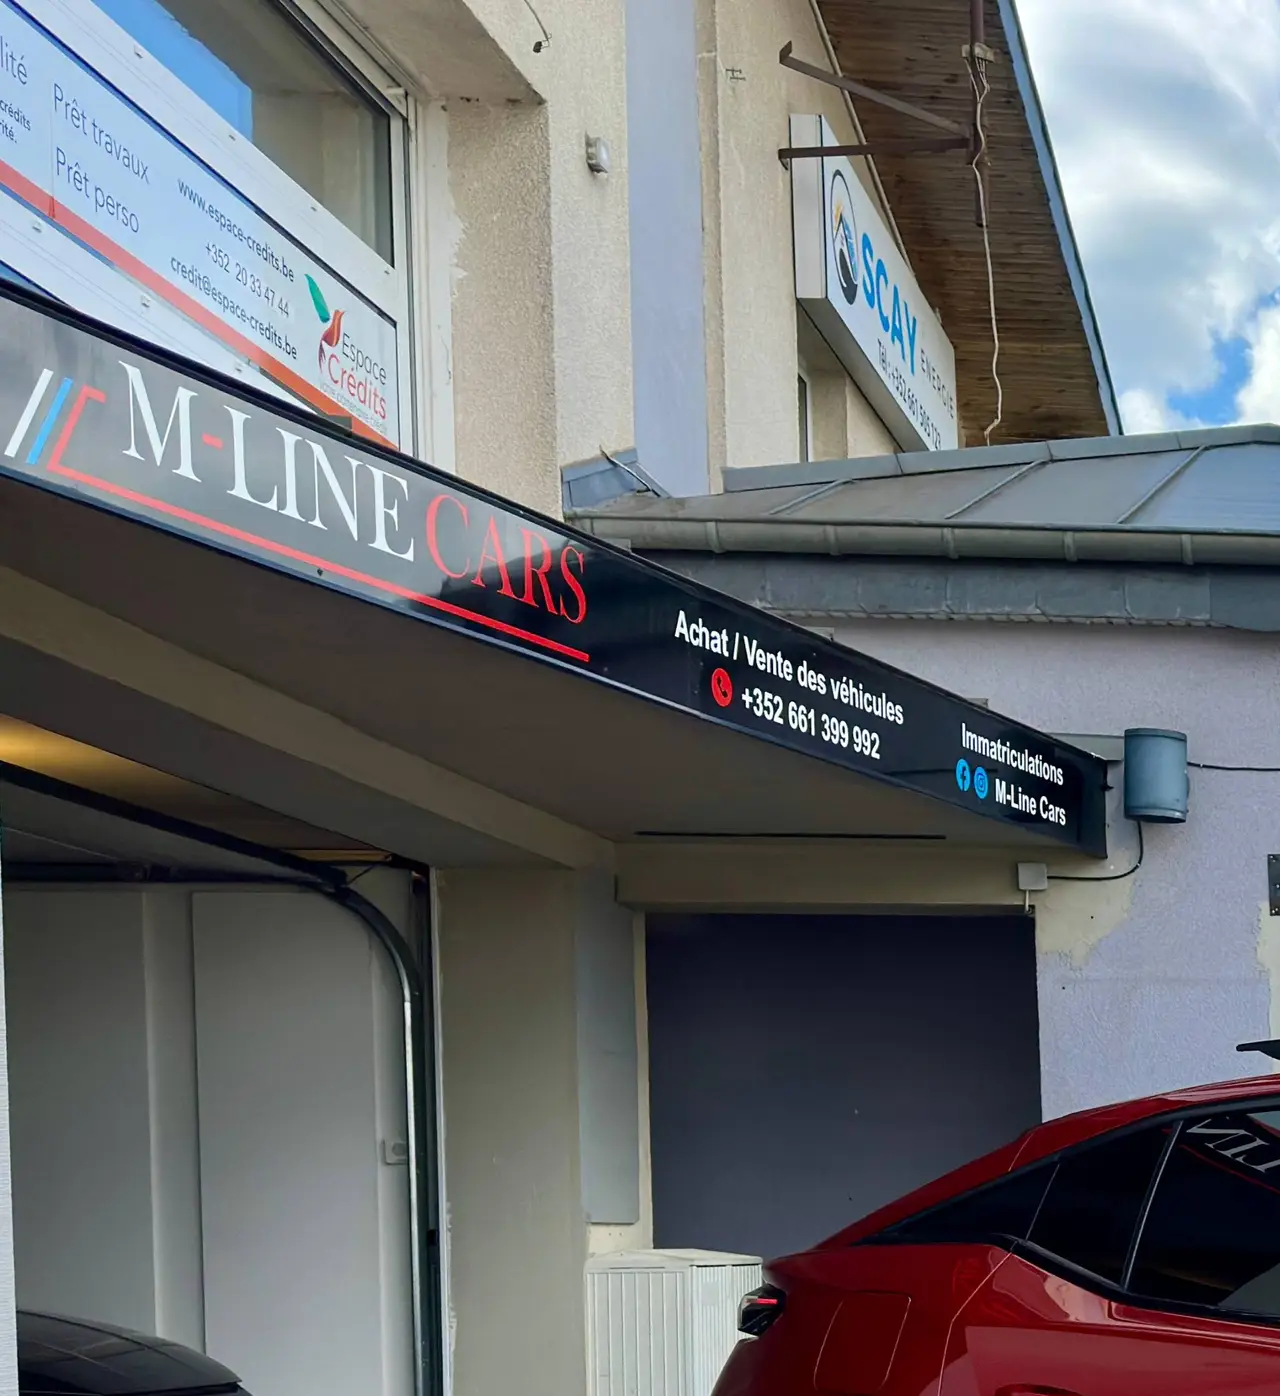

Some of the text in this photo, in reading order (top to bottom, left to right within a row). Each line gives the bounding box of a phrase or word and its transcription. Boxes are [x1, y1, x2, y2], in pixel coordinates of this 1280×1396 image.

[54, 83, 150, 184] Prêt travaux
[56, 147, 140, 233] Prêt perso
[178, 179, 295, 283] www.espace-credits.be
[170, 256, 298, 360] credit@espace-credits.be
[205, 242, 290, 318] +352 20 33 47 44
[861, 232, 917, 376] SCAY
[328, 353, 387, 419] Crédits
[342, 332, 387, 385] Espace
[118, 360, 587, 624] M-LINE CARS
[674, 610, 904, 726] Achat / Vente des véhicules
[742, 687, 881, 760] +352 661 399 992
[961, 722, 1064, 786] Immatriculations
[995, 779, 1067, 827] M-Line Cars
